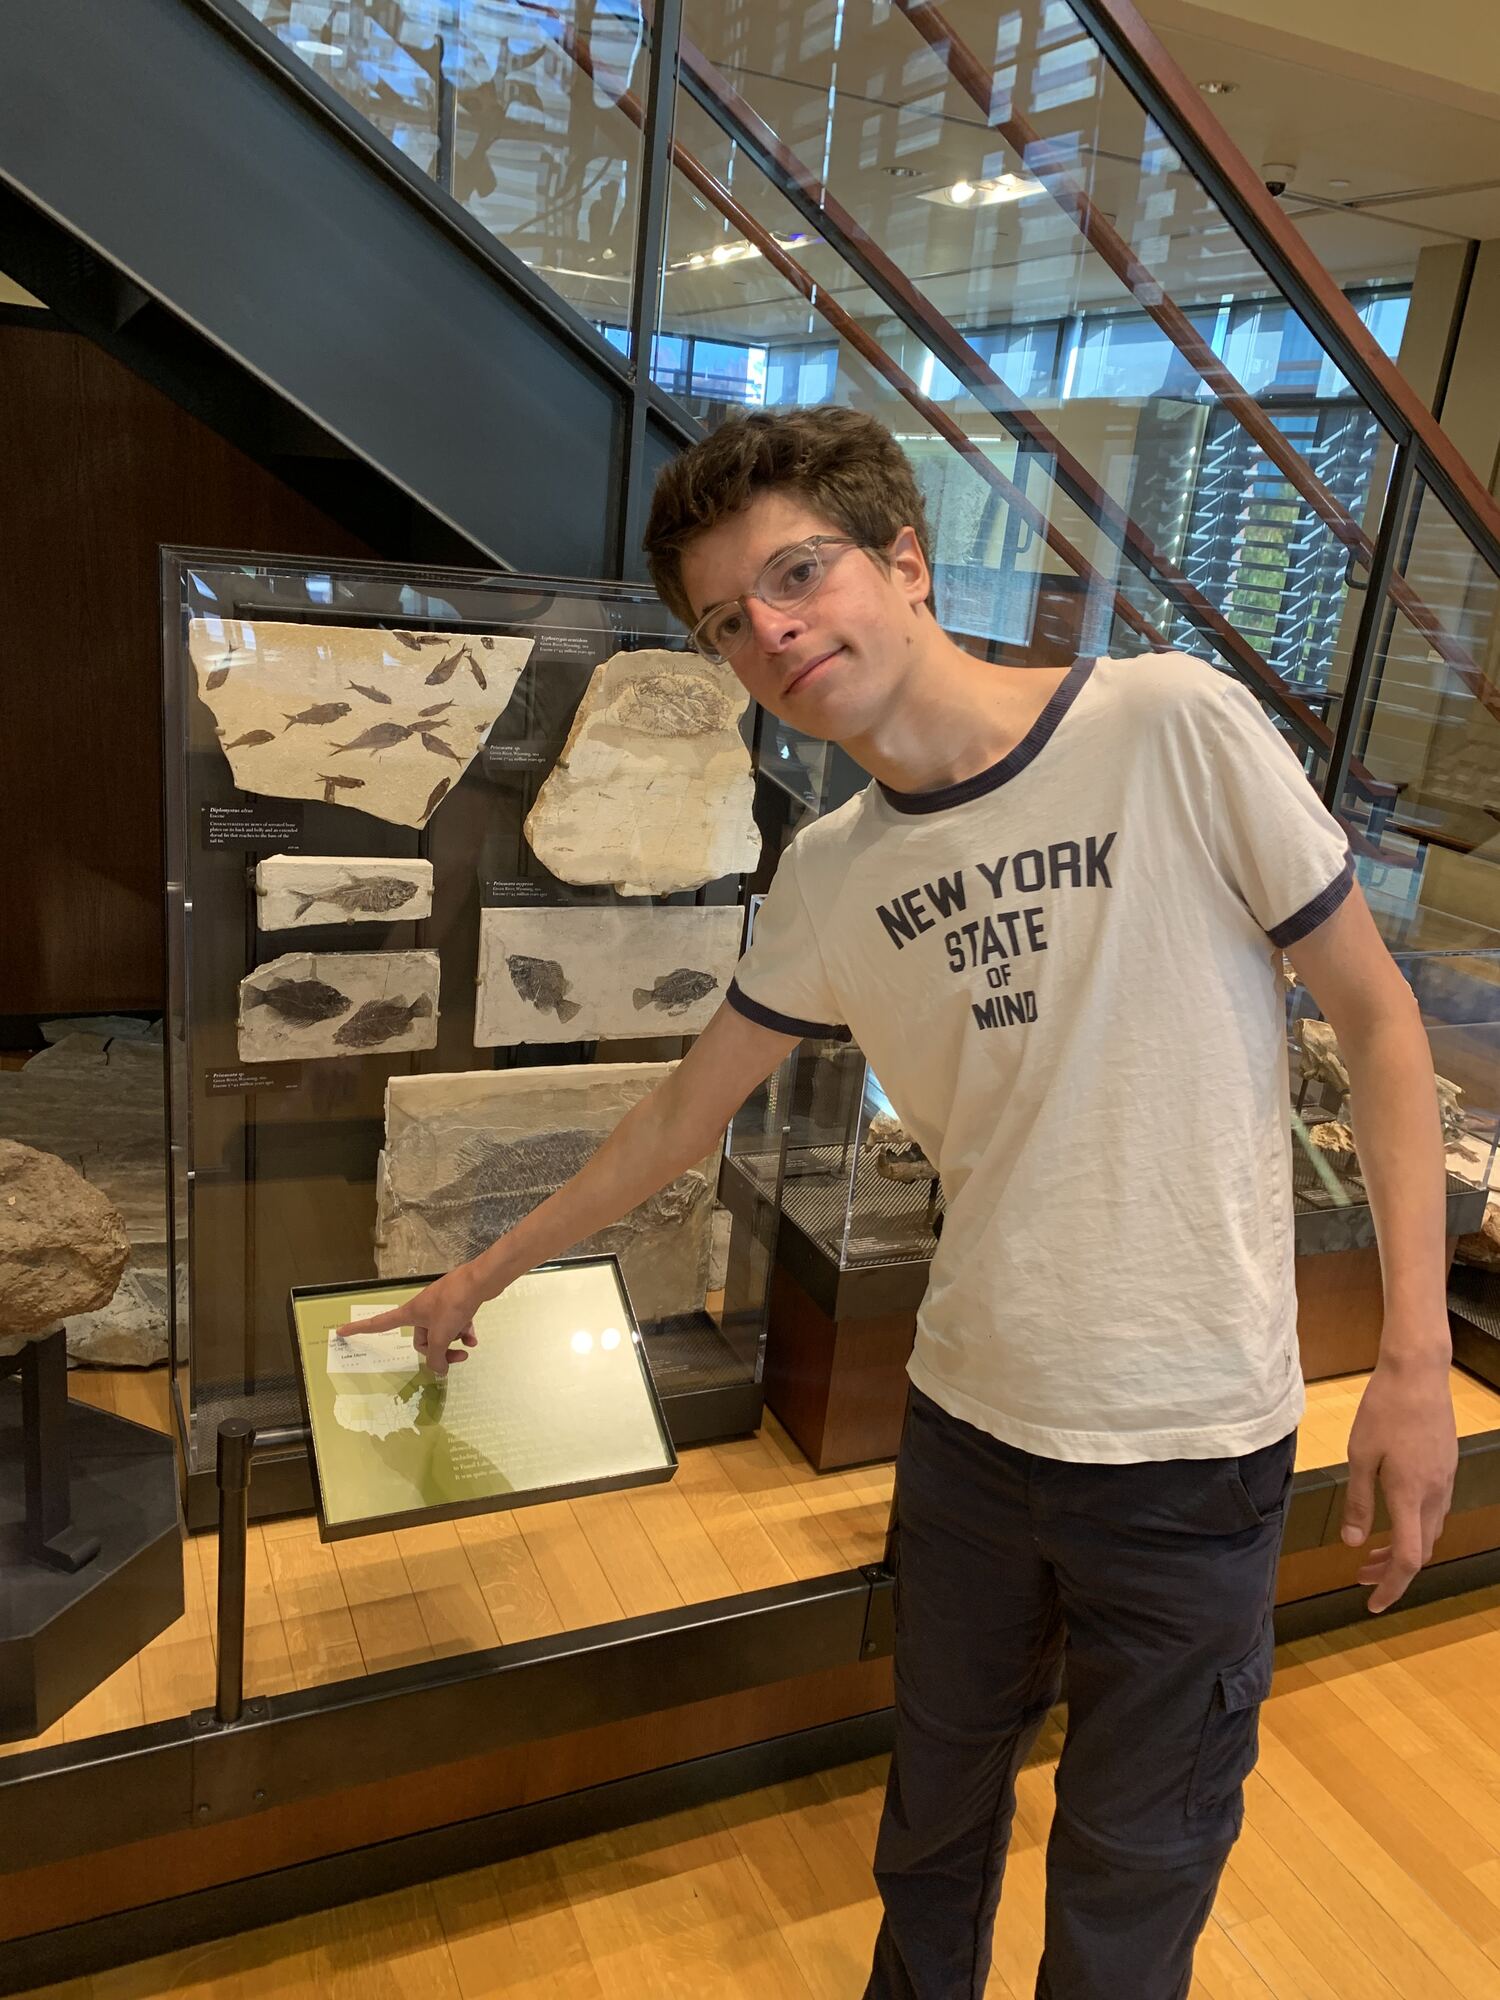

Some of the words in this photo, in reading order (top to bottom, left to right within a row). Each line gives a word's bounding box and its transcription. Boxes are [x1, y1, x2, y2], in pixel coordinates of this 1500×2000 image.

[876, 870, 966, 950] NEW
[976, 832, 1118, 900] YORK
[944, 906, 1048, 974] STATE
[986, 964, 1012, 988] OF
[972, 990, 1038, 1030] MIND
